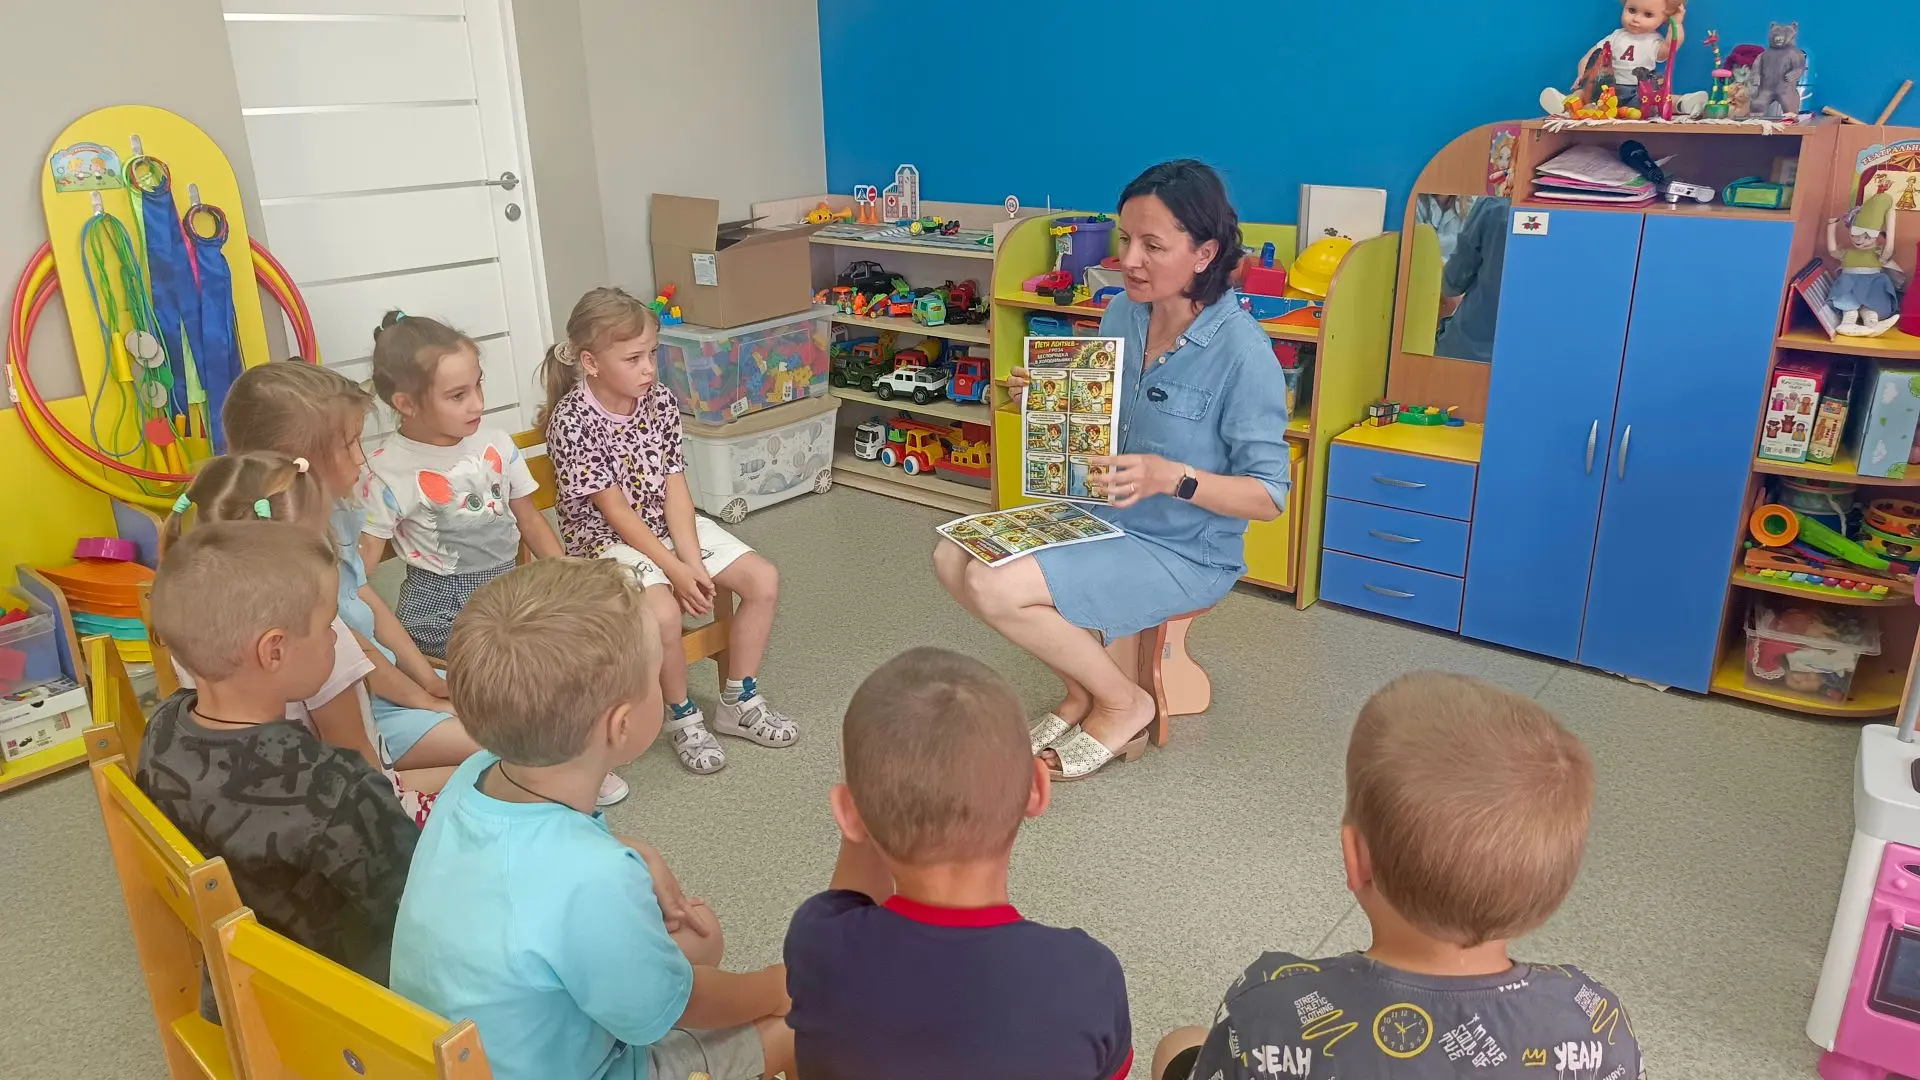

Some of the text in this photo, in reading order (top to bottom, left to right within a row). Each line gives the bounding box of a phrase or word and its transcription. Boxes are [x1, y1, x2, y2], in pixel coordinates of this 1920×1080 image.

[1620, 45, 1634, 61] A
[1294, 990, 1320, 1009] STREET
[1297, 996, 1328, 1017] ATHLETIC
[1300, 1002, 1334, 1024] CLOTHING
[1252, 1045, 1312, 1076] YEAH
[1553, 1040, 1603, 1072] YEAH
